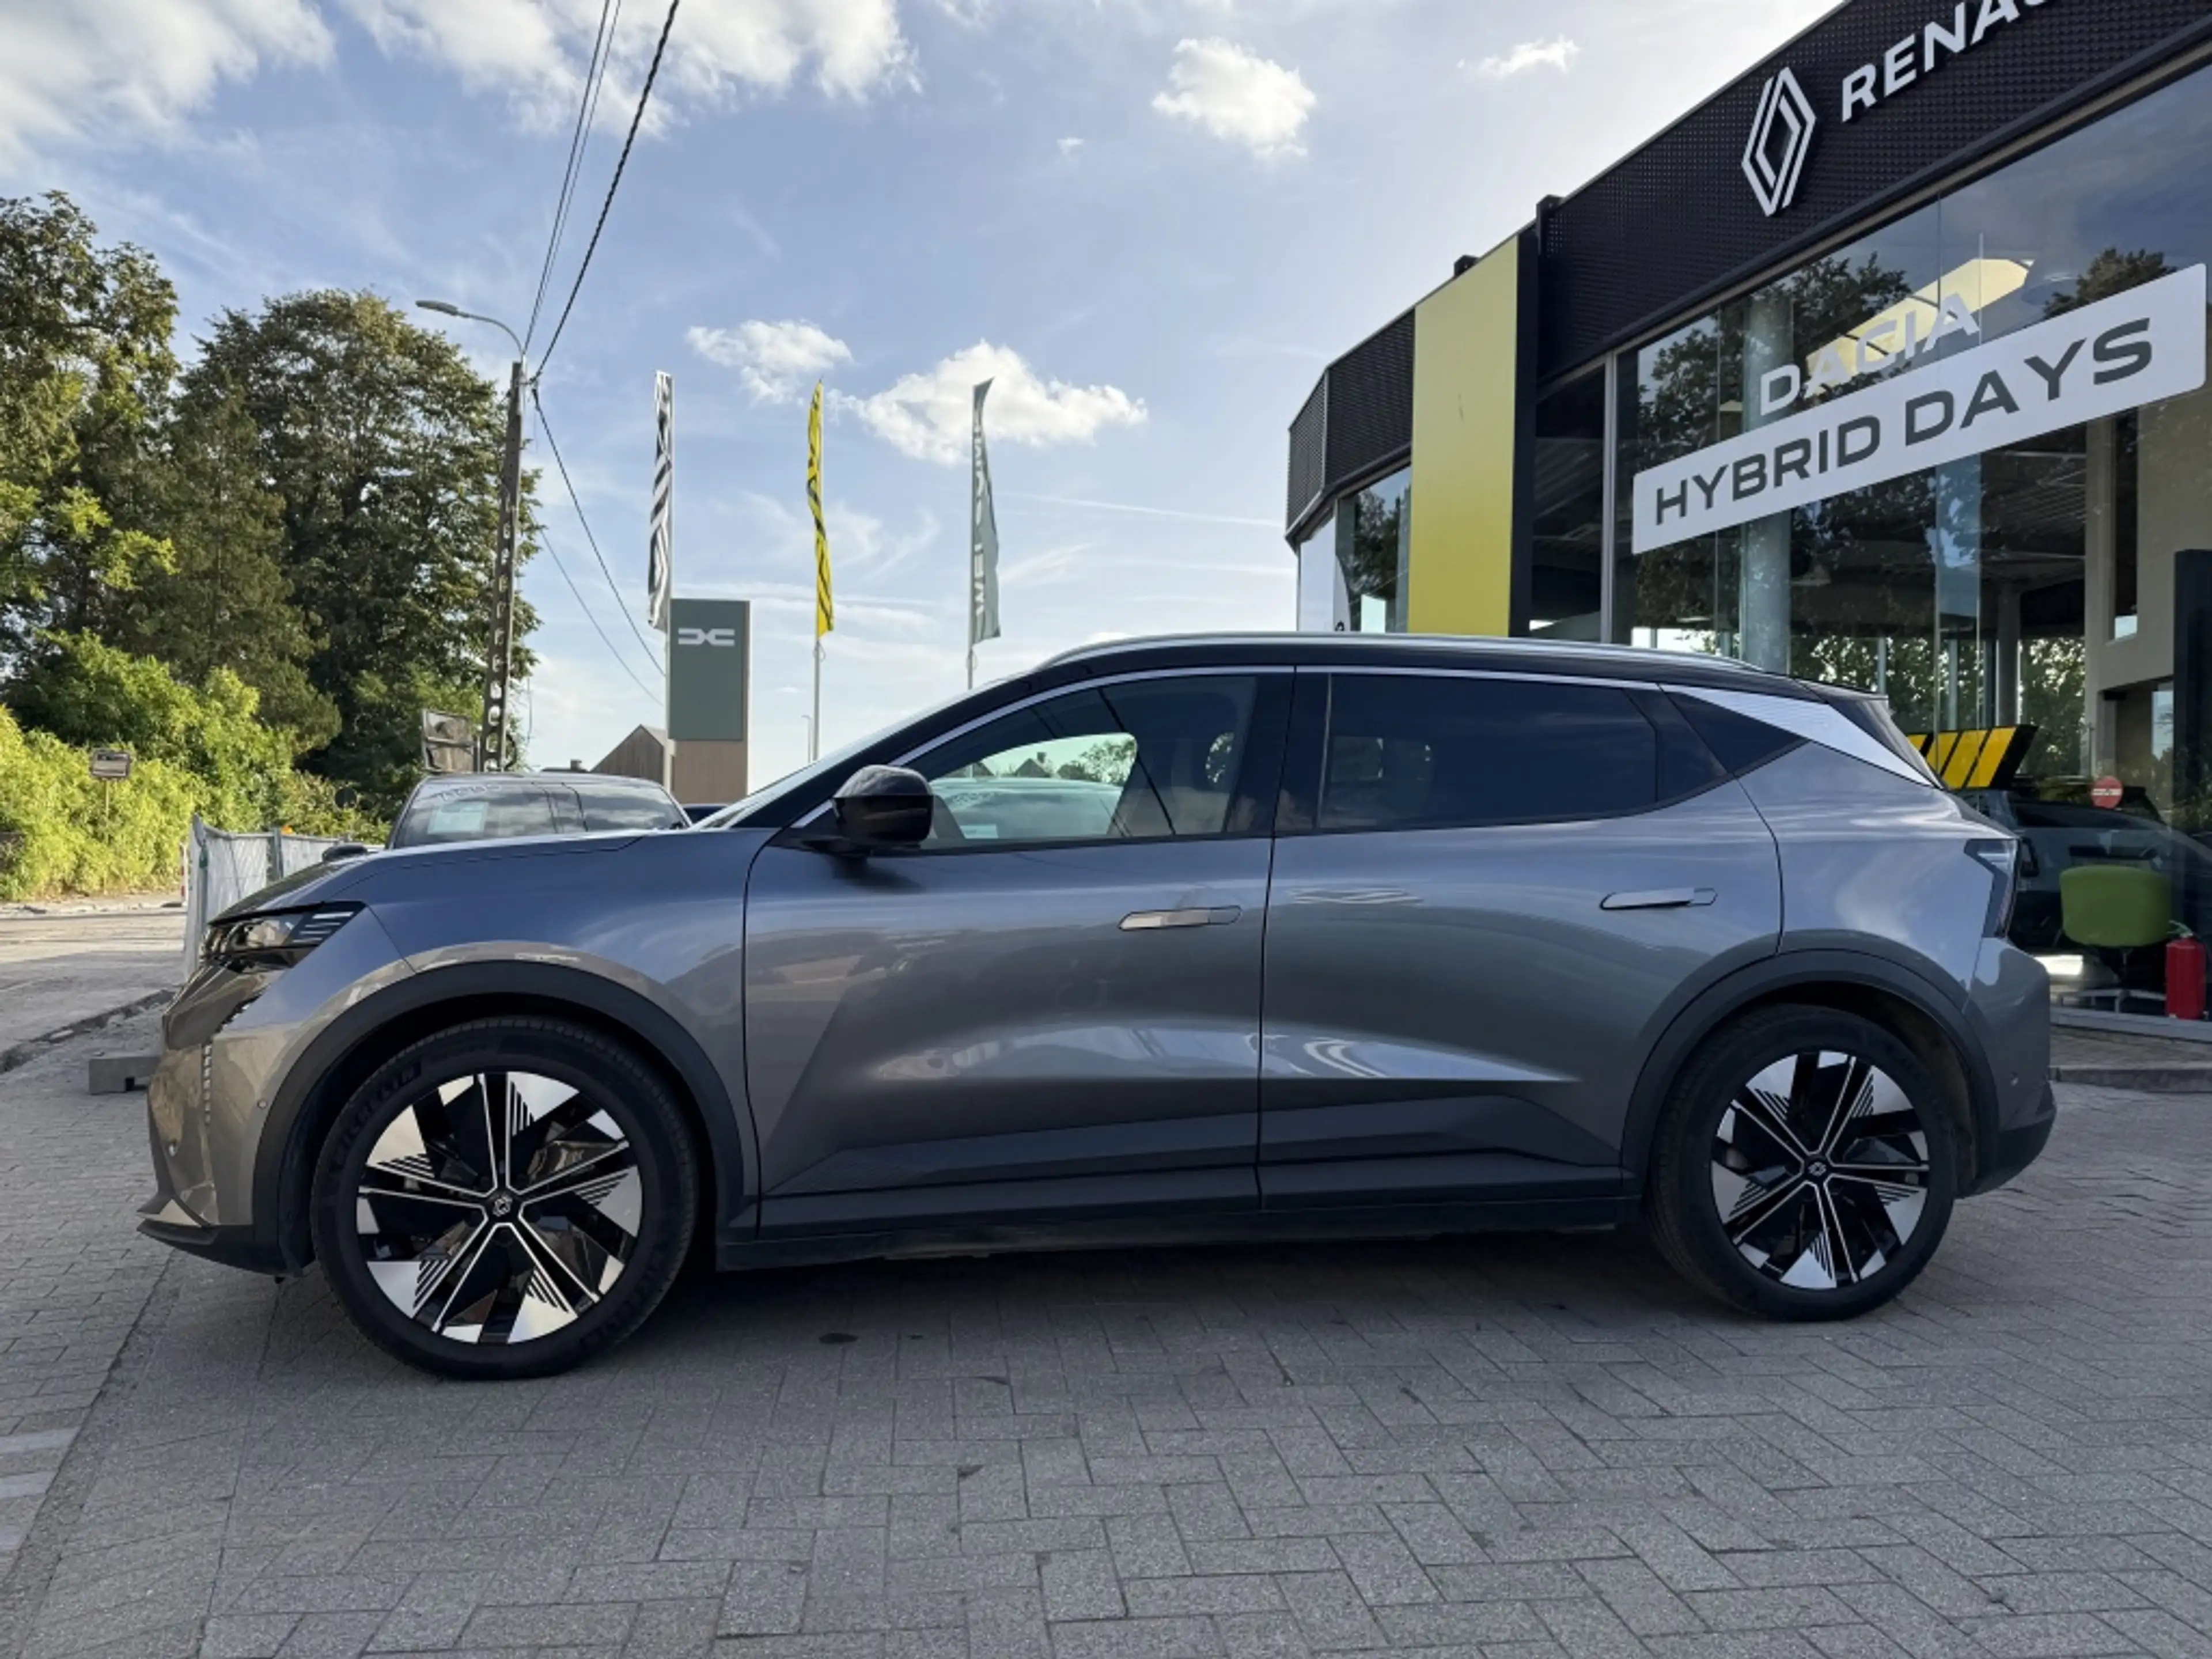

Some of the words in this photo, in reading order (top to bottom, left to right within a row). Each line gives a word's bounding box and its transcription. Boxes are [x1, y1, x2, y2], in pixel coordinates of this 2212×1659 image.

[1842, 0, 2045, 123] RENA
[1760, 292, 1980, 416] DACIA
[1656, 415, 1881, 525] HYBRID
[1905, 317, 2153, 446] DAYS
